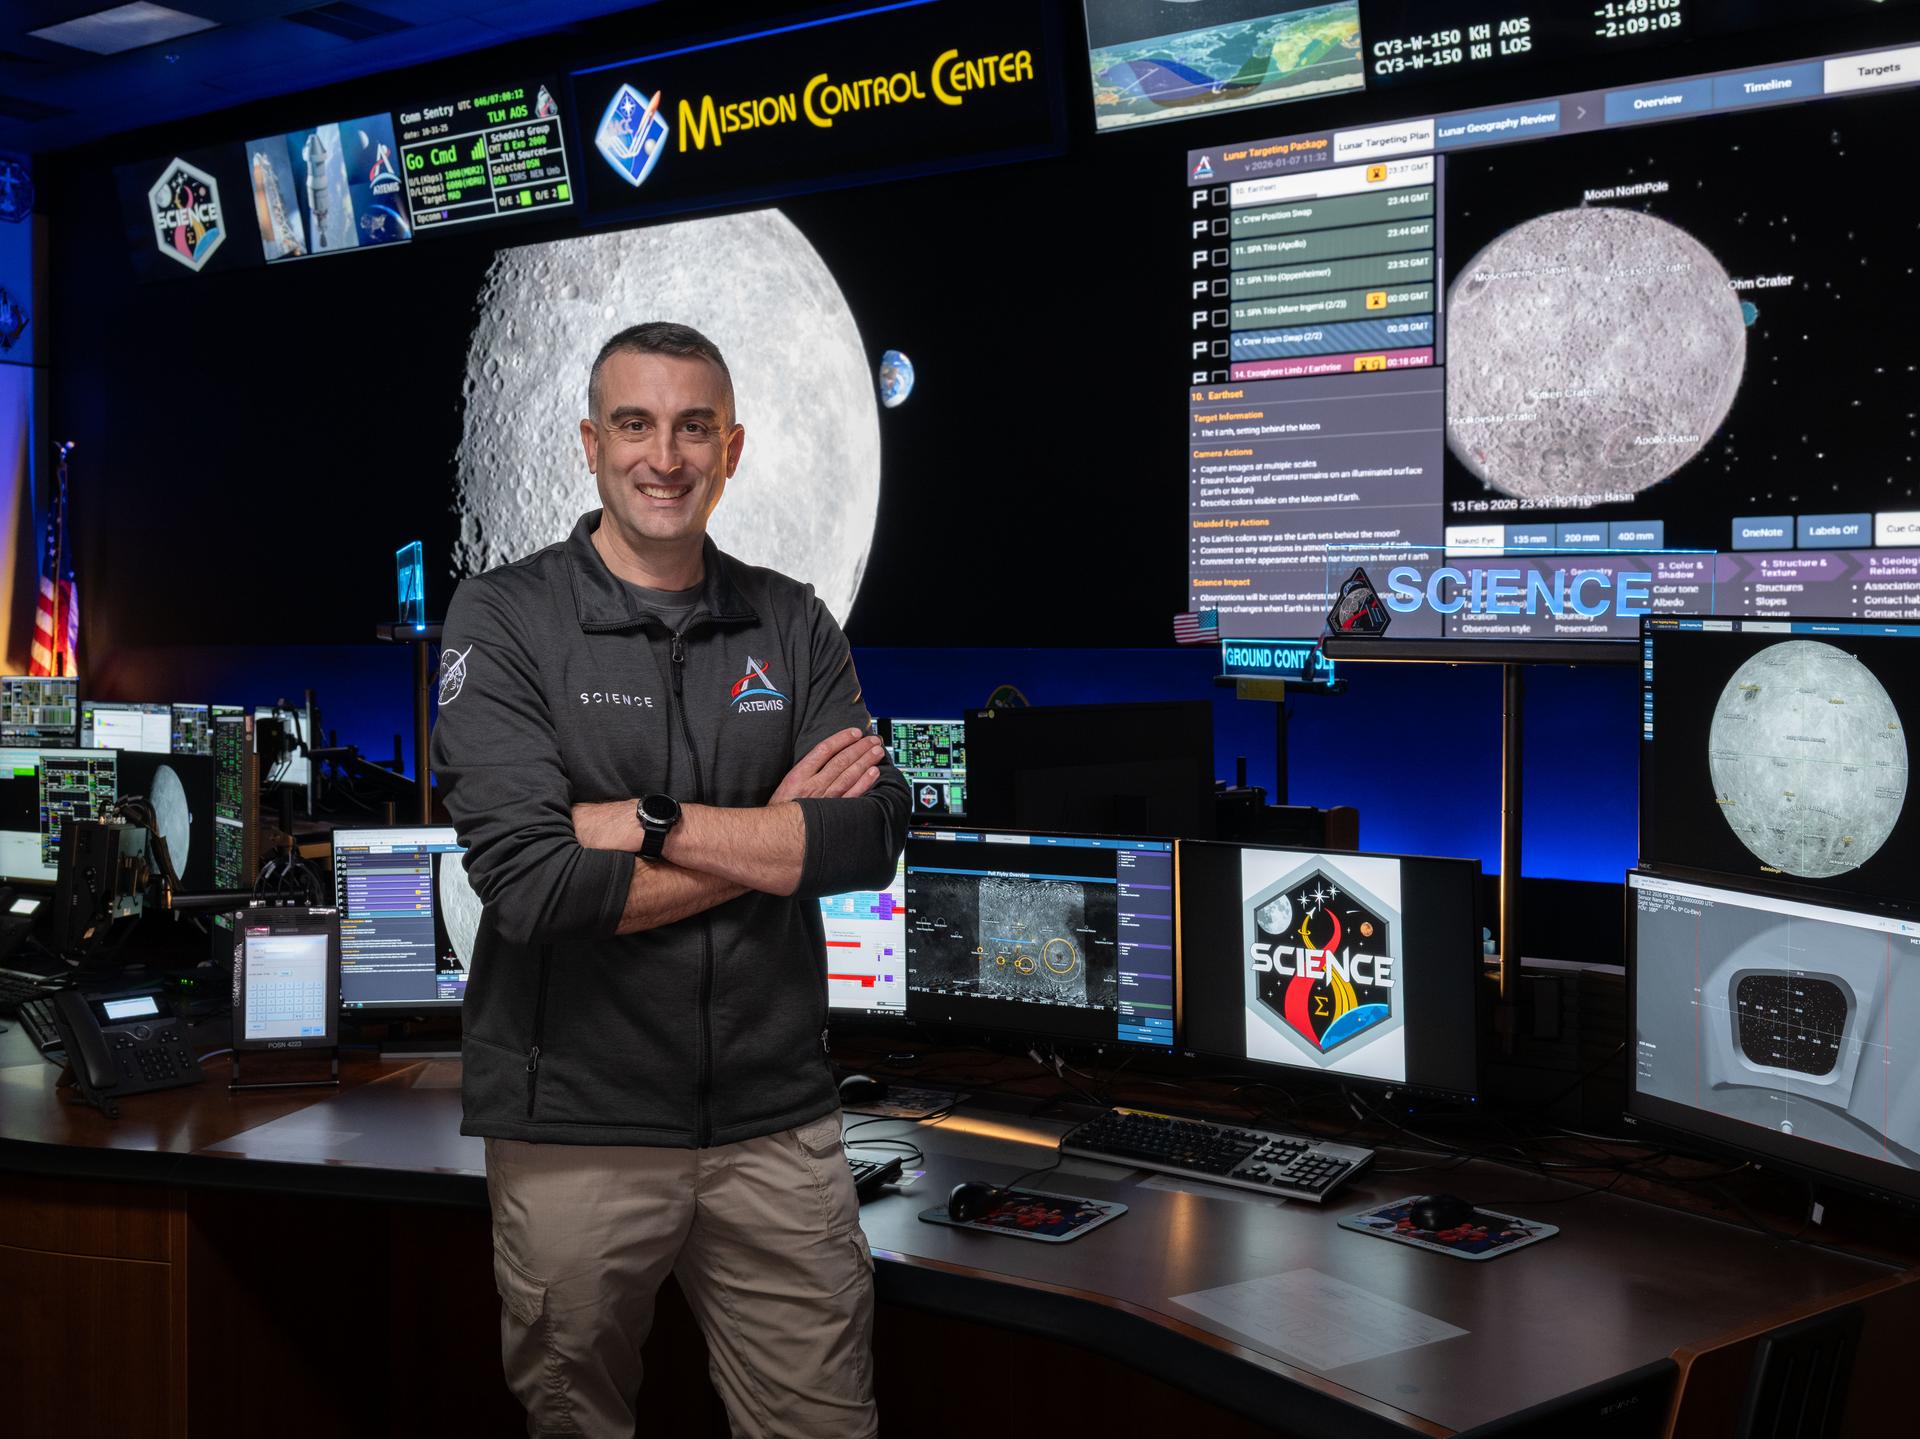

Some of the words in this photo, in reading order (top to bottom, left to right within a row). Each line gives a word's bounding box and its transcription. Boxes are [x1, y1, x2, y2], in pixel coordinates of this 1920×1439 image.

[1595, 12, 1681, 38] -2:09:03
[1373, 30, 1461, 57] CY3-W-150
[1469, 24, 1490, 40] KH
[1499, 18, 1530, 37] AOS
[1375, 48, 1462, 74] CY3-W-150
[1470, 43, 1492, 59] KH
[1501, 36, 1531, 55] LOS
[1858, 62, 1901, 76] Targets
[1744, 78, 1792, 93] Timeline
[1634, 94, 1683, 110] Overview
[423, 105, 454, 120] Sentry
[487, 109, 506, 123] TLM
[510, 105, 528, 119] AOS
[1439, 126, 1465, 137] Lunar
[1467, 118, 1519, 133] Geography
[1520, 113, 1556, 125] Review
[490, 128, 525, 143] Schedule
[527, 125, 550, 136] Group
[1339, 141, 1363, 151] Lunar
[1366, 136, 1407, 147] Targeting
[1410, 132, 1429, 140] Plan
[1224, 151, 1248, 161] Lunar
[1249, 145, 1289, 157] Targeting
[1290, 140, 1328, 151] Package
[406, 153, 424, 170] Go
[430, 145, 457, 165] Cmd
[492, 161, 525, 175] Selected
[1584, 187, 1612, 202] Moon
[1616, 180, 1669, 197] NorthPole
[158, 203, 218, 230] SCIENCE
[1242, 215, 1261, 224] Crew
[1261, 211, 1291, 222] Position
[1292, 208, 1312, 217] Swap
[1264, 243, 1277, 251] Trio
[1278, 239, 1306, 251] (Apollo)
[1728, 279, 1753, 291] Ohm
[1756, 275, 1794, 289] Crater
[1410, 291, 1429, 300] GMT
[1247, 368, 1284, 377] Exosphere
[1284, 366, 1302, 374] Limb
[1308, 364, 1342, 373] Earthrise
[1191, 392, 1204, 401] 10.
[1208, 390, 1244, 401] Earthset
[1194, 414, 1217, 423] Target
[1219, 411, 1264, 421] Information
[1236, 426, 1260, 436] setting
[1261, 425, 1285, 433] behind
[1286, 424, 1298, 432] the
[1299, 423, 1320, 431] Moon
[1668, 433, 1699, 443] Basin
[1194, 450, 1222, 458] Camera
[1201, 465, 1227, 474] Capture
[1228, 464, 1254, 472] images
[1264, 461, 1292, 470] multiple
[1294, 460, 1317, 468] scales
[1243, 475, 1262, 483] point
[1263, 474, 1271, 482] of
[1300, 472, 1328, 480] remains
[1351, 468, 1392, 477] illuminated
[1394, 467, 1423, 475] surface
[1201, 499, 1230, 507] Describe
[1231, 498, 1253, 506] colors
[1255, 497, 1276, 505] visible
[1301, 495, 1322, 503] Moon
[1324, 494, 1338, 502] and
[1605, 492, 1635, 501] Basin
[1452, 502, 1465, 512] 13
[1467, 500, 1488, 511] Feb
[1490, 500, 1518, 510] 2026
[1193, 520, 1224, 528] Unaided
[1225, 520, 1239, 528] Eye
[1809, 526, 1841, 536] Labels
[1843, 525, 1859, 535] Off
[1235, 534, 1257, 542] colors
[1258, 534, 1272, 542] vary
[1284, 532, 1296, 540] the
[1297, 532, 1316, 540] Earth
[1317, 532, 1333, 540] sets
[1334, 531, 1359, 539] behind
[1374, 530, 1400, 538] moon?
[1565, 534, 1581, 542] 200
[1618, 532, 1635, 541] 400
[1742, 529, 1783, 537] OneNote
[1513, 536, 1528, 544] 135
[1200, 547, 1233, 555] Comment
[1245, 546, 1258, 555] any
[1259, 545, 1293, 553] variations
[1773, 559, 1817, 567] Structure
[1819, 559, 1827, 567] &
[1658, 571, 1694, 579] Shadow
[1761, 569, 1797, 577] Texture
[1870, 566, 1917, 575] Relations
[1193, 579, 1222, 587] Science
[1224, 579, 1251, 587] Impact
[1756, 584, 1803, 592] Structures
[1387, 567, 1652, 616] SCIENCE
[1653, 598, 1684, 607] Albedo
[1756, 597, 1787, 607] Slopes
[1462, 624, 1510, 633] Observation
[1511, 624, 1531, 633] style
[1226, 648, 1272, 667] GROUND
[1274, 649, 1335, 670] CONTOL
[580, 693, 653, 707] SCIENCE
[738, 700, 784, 713] ARTEMIS
[1250, 943, 1396, 988] SCIENCE
